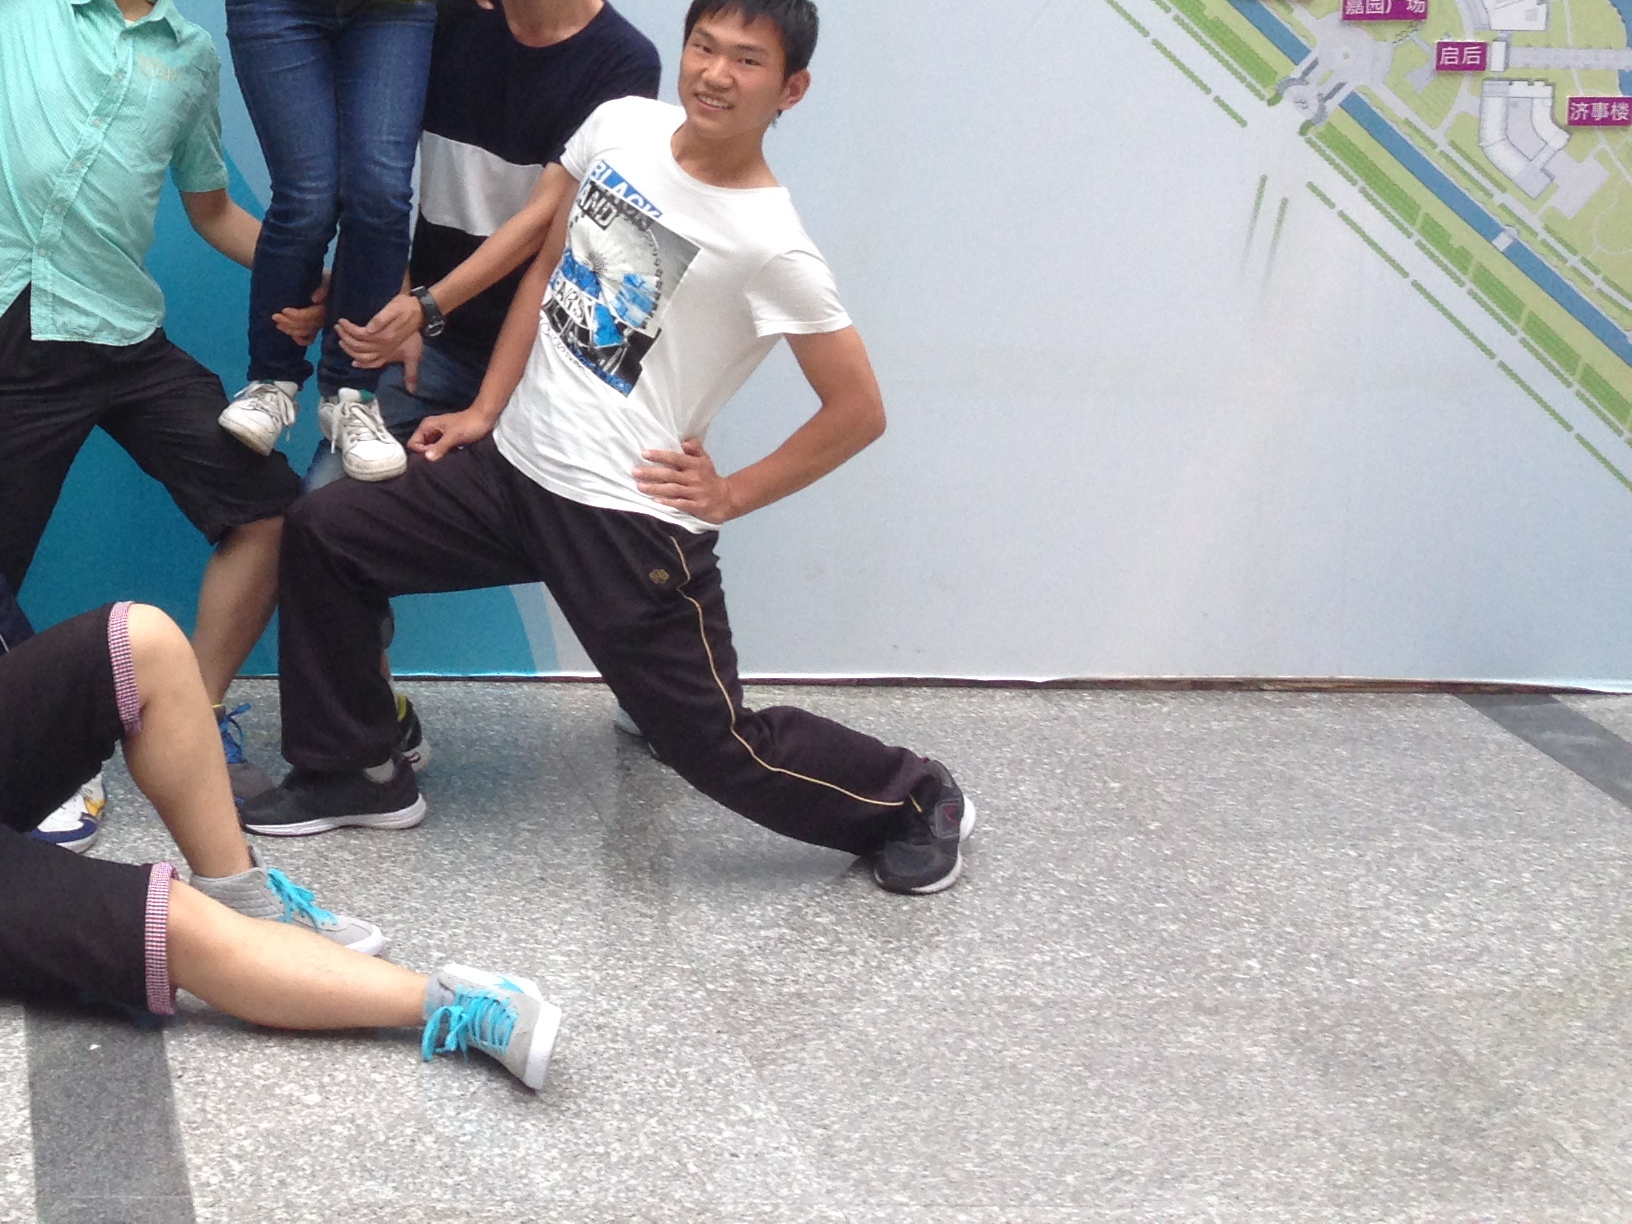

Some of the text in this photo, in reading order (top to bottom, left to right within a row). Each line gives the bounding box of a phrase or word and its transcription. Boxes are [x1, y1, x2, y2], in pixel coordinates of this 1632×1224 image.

[1439, 45, 1482, 67] 启后
[1569, 100, 1630, 122] 济事楼
